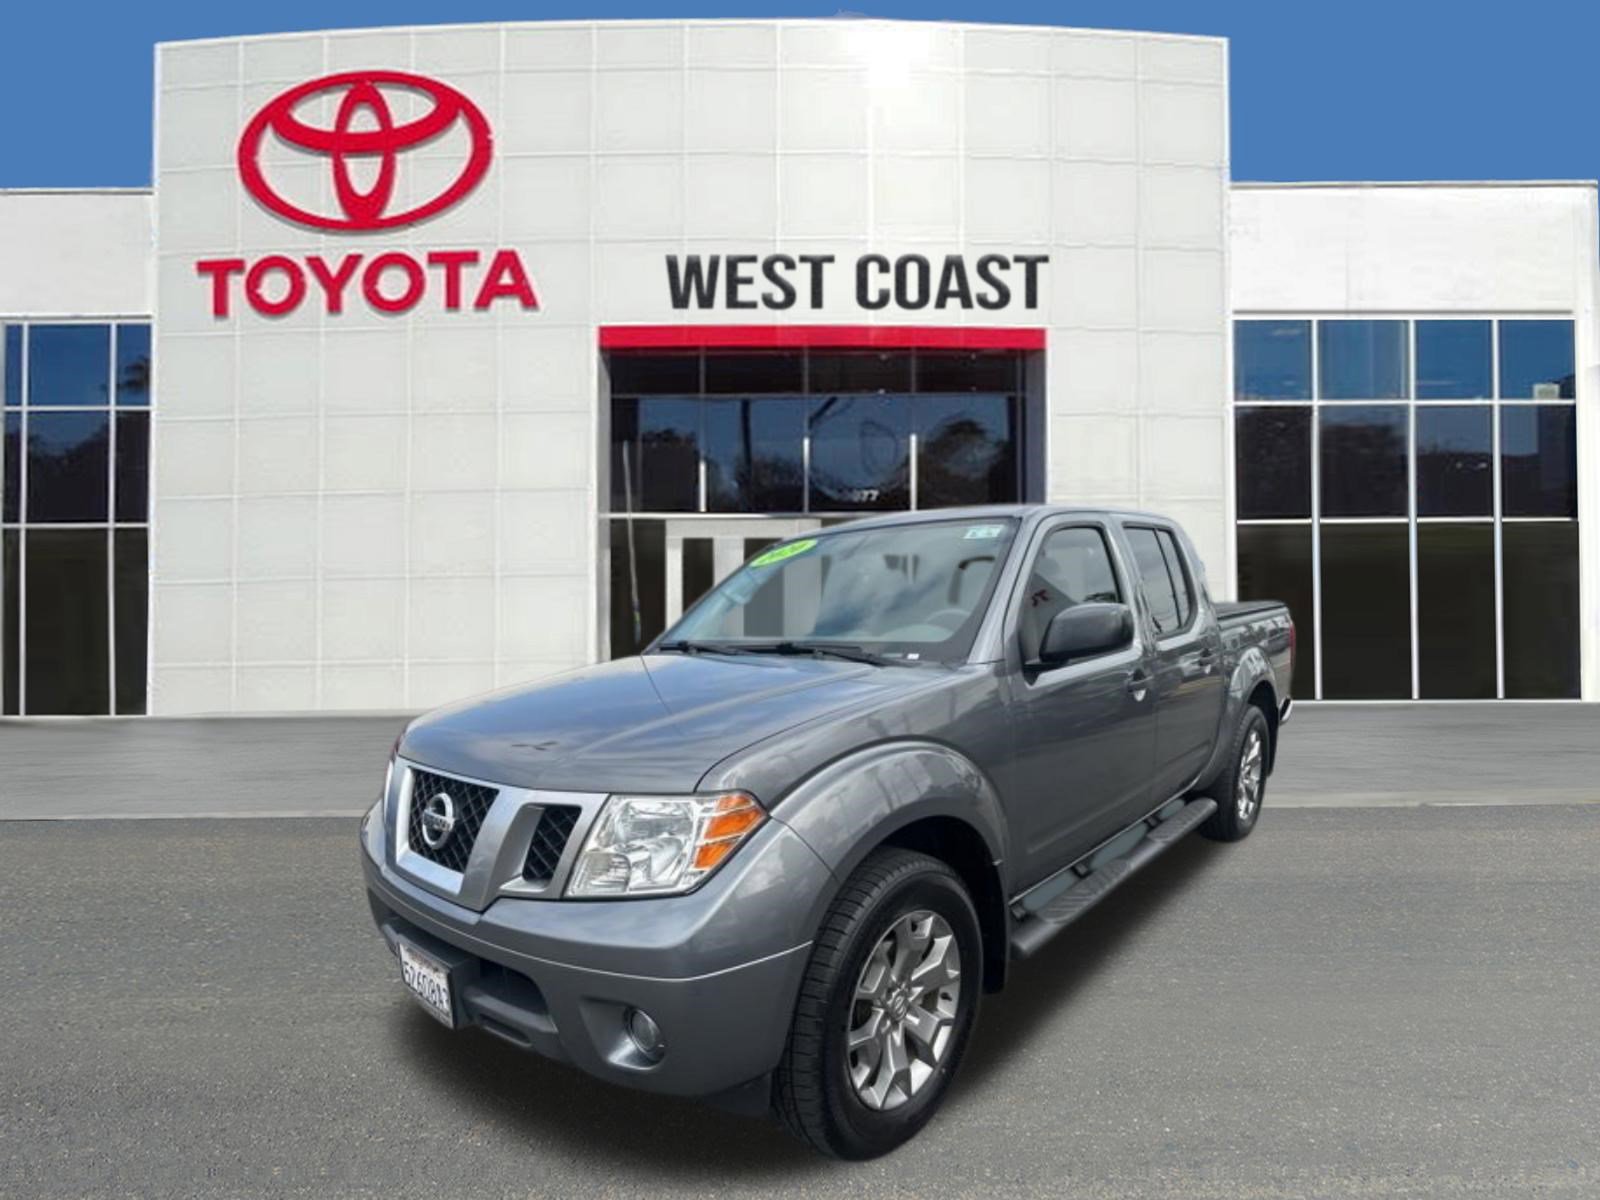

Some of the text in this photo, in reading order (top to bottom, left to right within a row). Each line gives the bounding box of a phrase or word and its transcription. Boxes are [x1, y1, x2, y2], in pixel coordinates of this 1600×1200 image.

[197, 250, 539, 317] TOYOTA
[666, 253, 1050, 310] WEST COAST
